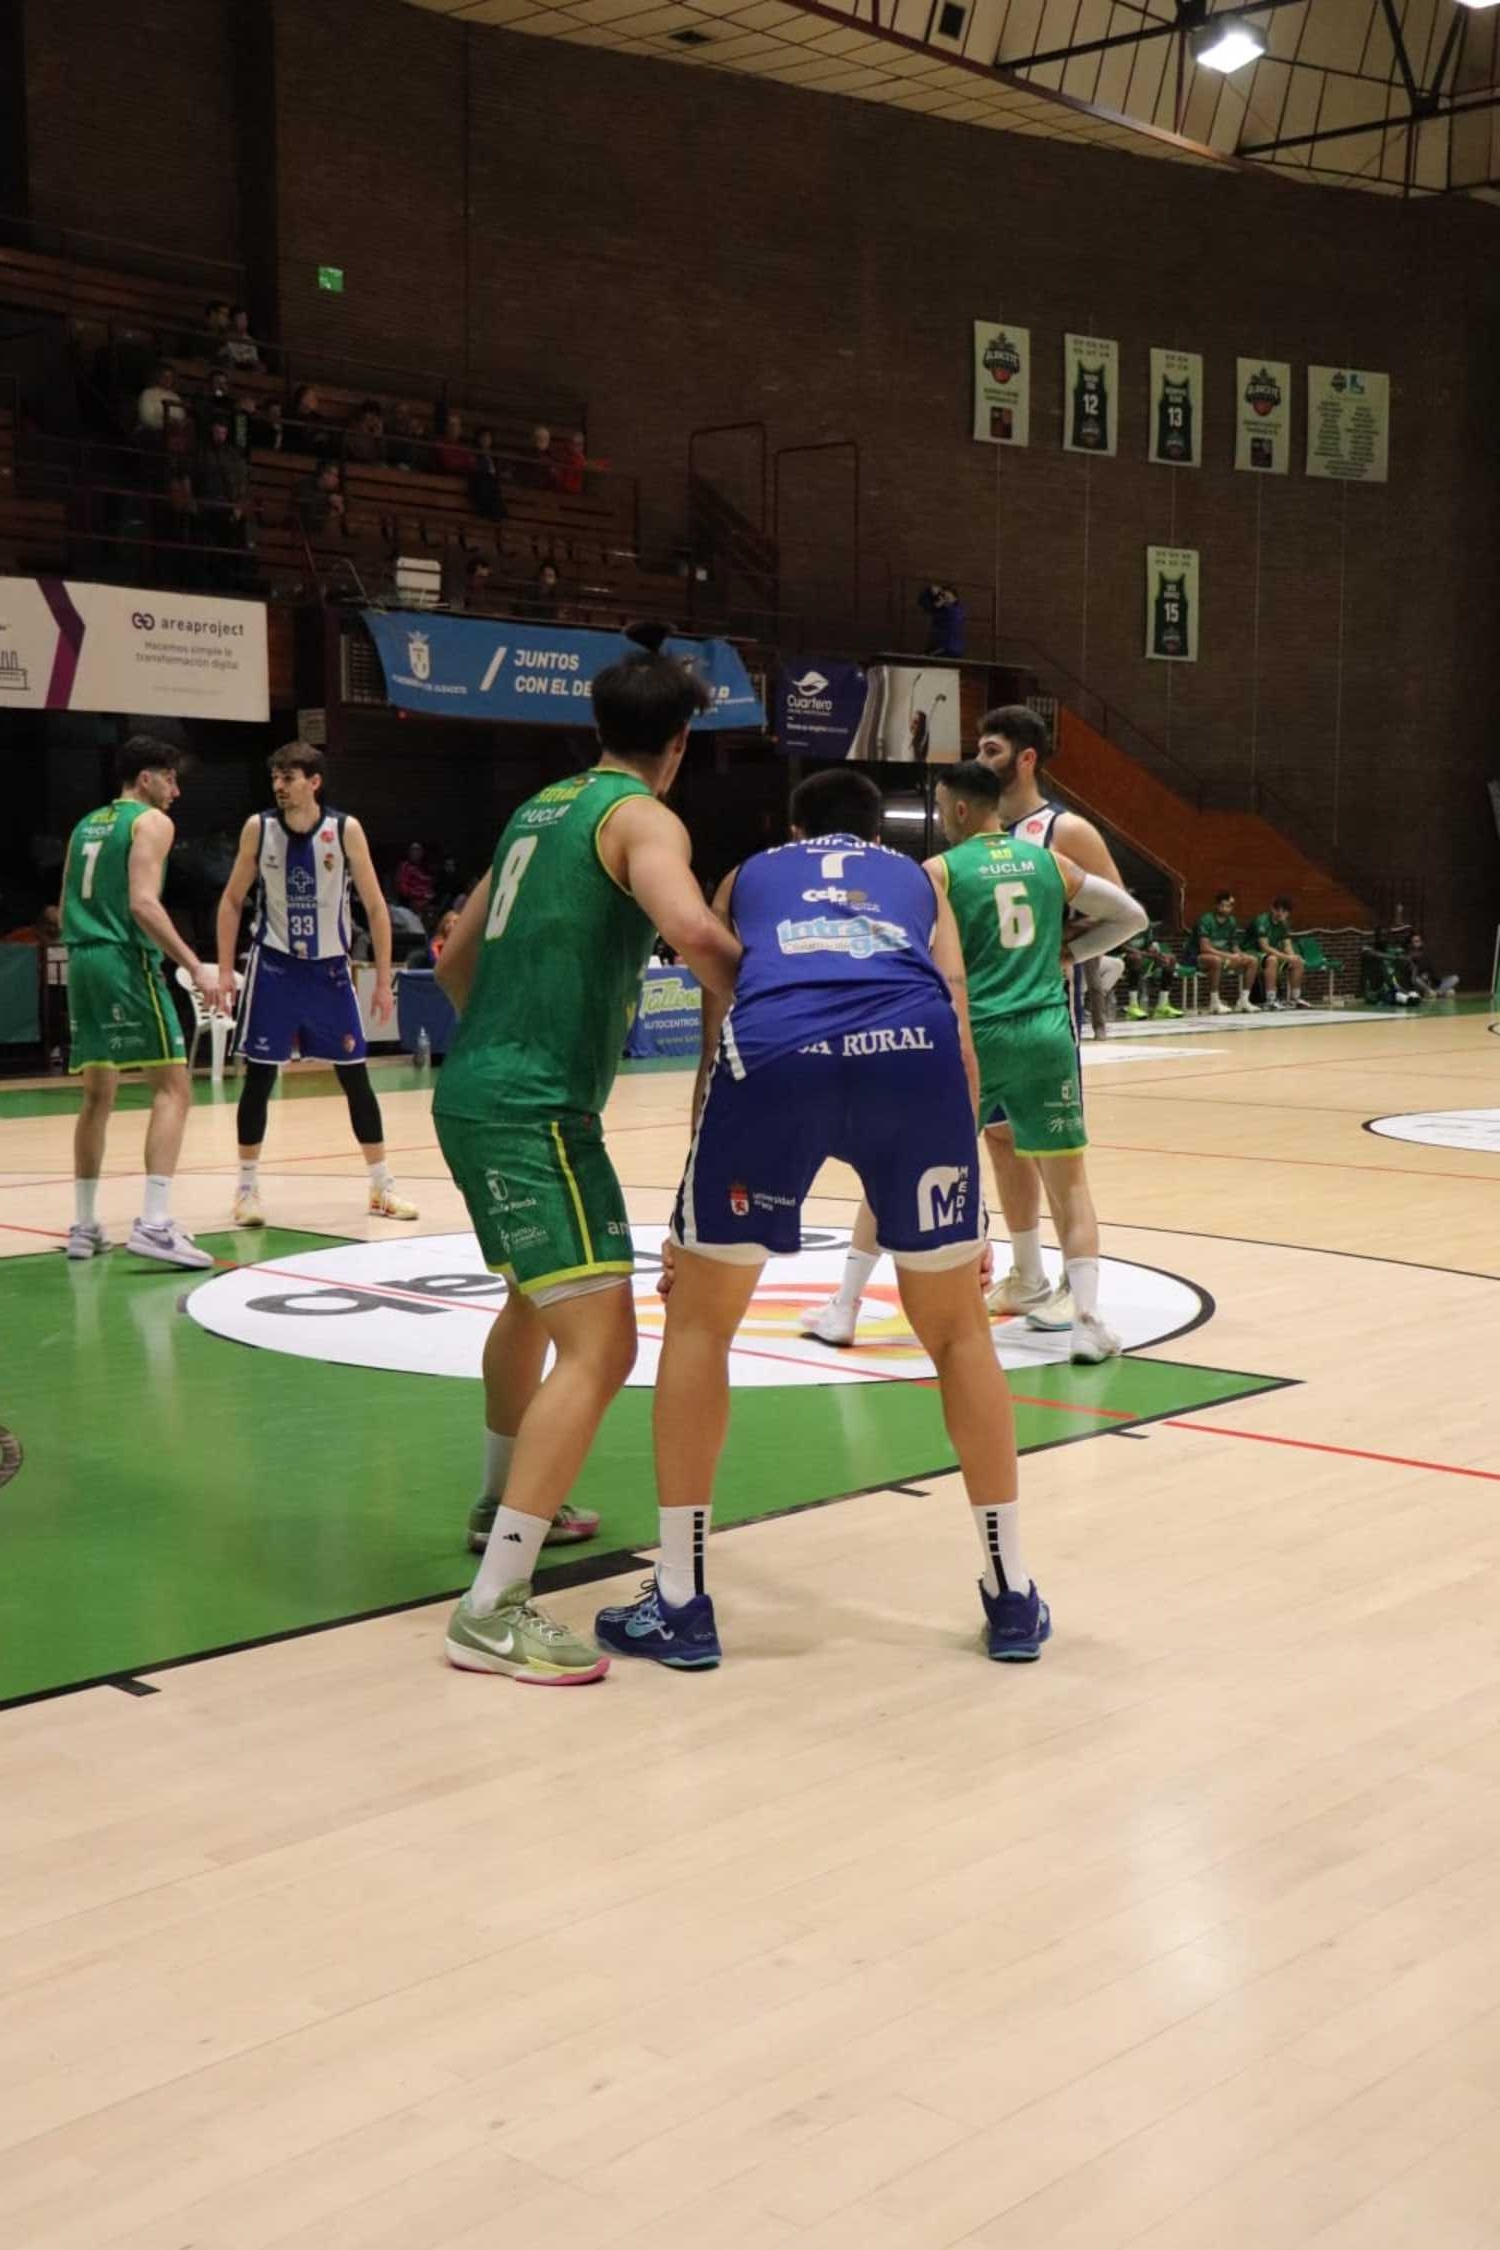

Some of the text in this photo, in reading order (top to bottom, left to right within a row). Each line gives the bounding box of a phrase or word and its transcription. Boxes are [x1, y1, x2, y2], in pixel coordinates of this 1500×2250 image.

[1083, 393, 1099, 415] 12
[1168, 406, 1183, 427] 13
[1164, 602, 1179, 623] 15
[161, 618, 244, 637] areaproject
[145, 641, 188, 653] Hacemos
[190, 647, 222, 657] simple
[211, 659, 239, 671] digital
[513, 649, 580, 671] JUNTOS
[515, 674, 594, 697] CON EL DE
[786, 694, 832, 712] Cuartero
[989, 860, 1036, 875] UCLM
[485, 835, 538, 941] 8
[291, 915, 314, 936] 33
[994, 881, 1036, 949] 6
[842, 1027, 934, 1057] RURAL
